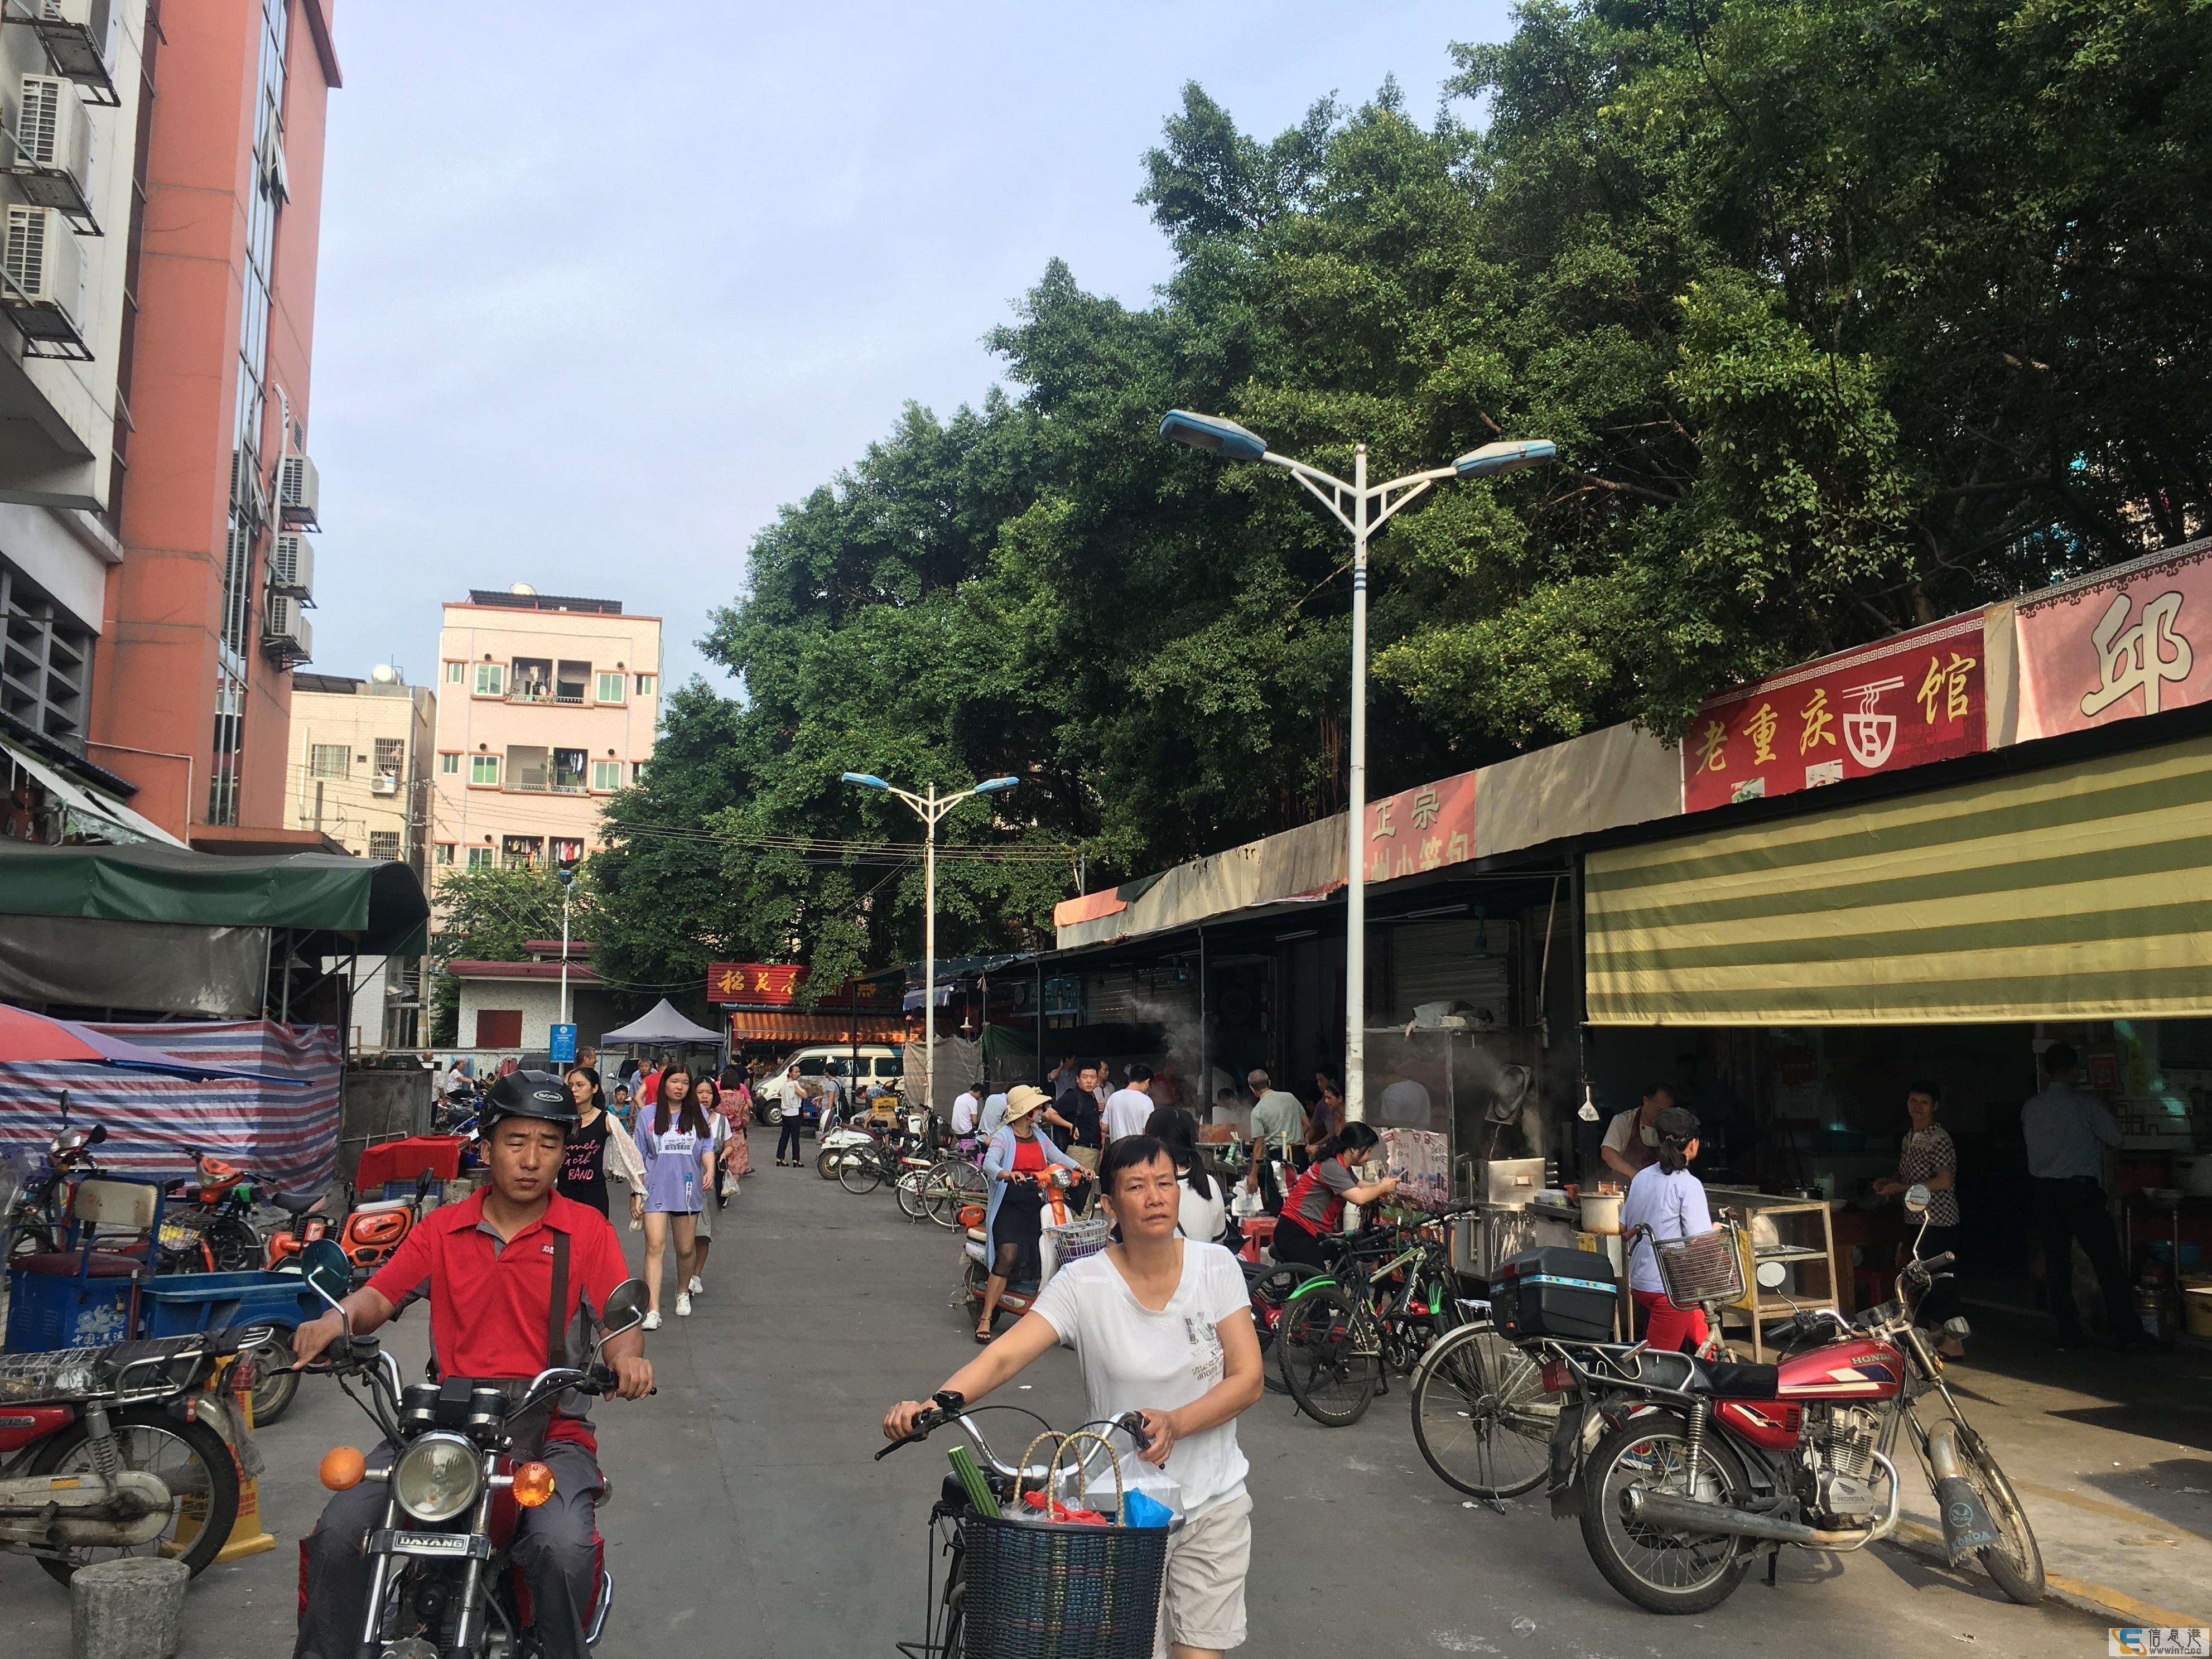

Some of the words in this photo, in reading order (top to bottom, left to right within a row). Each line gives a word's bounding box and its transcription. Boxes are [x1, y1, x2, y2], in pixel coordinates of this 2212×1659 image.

[1371, 787, 1440, 842] 正宗
[568, 1166, 594, 1181] BAND
[1851, 1353, 1895, 1365] HONDA
[399, 1536, 463, 1547] DAYANG
